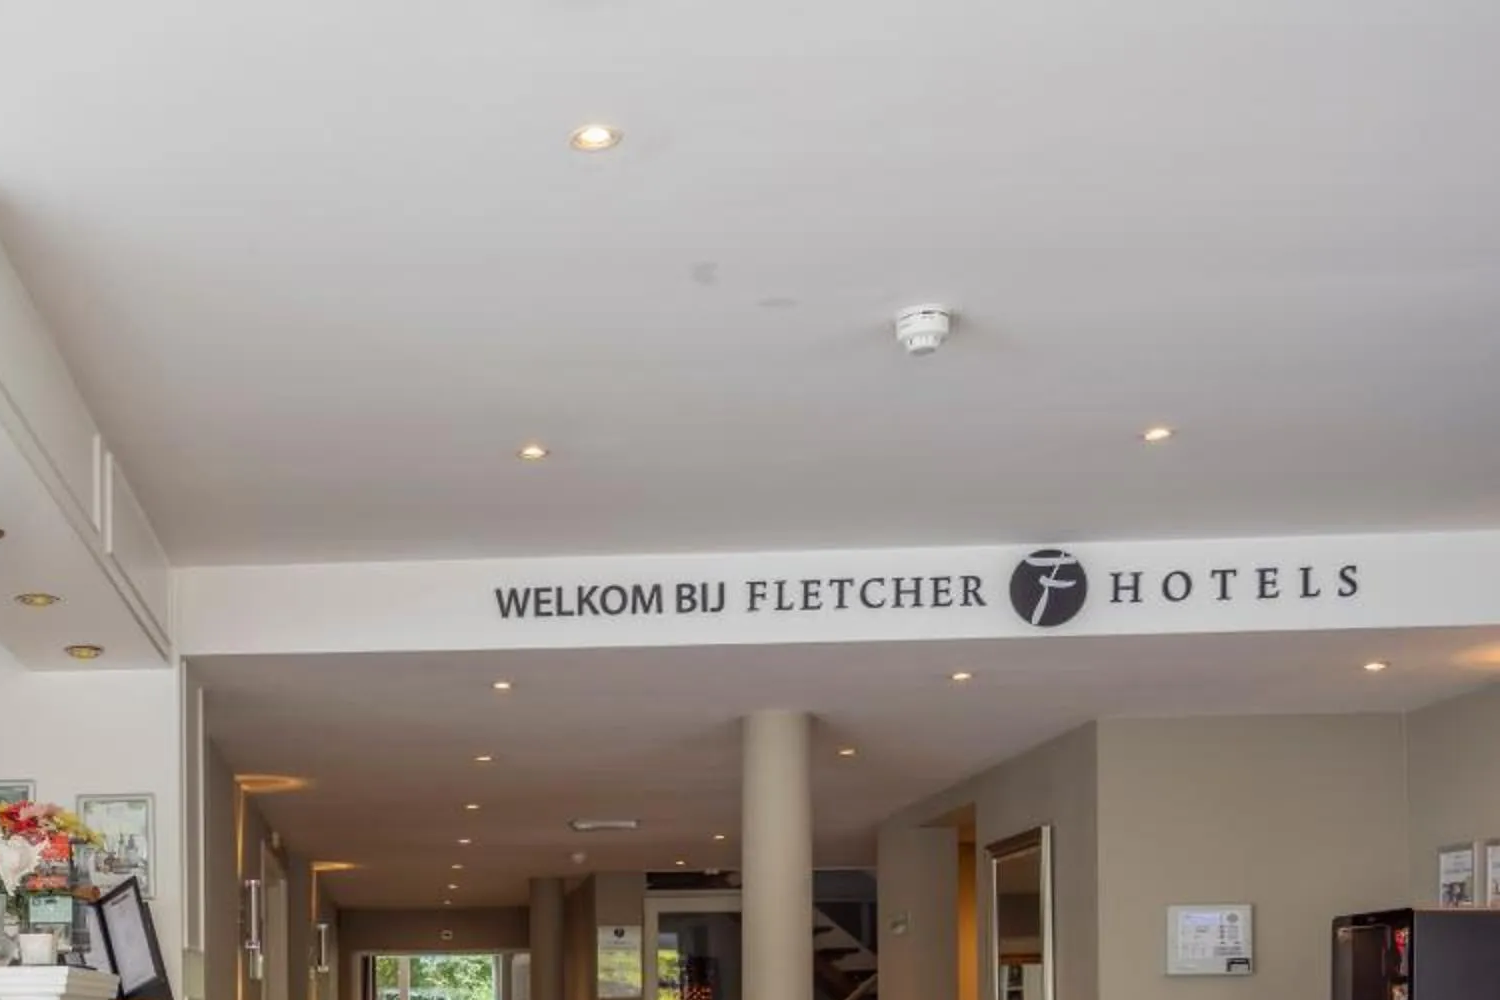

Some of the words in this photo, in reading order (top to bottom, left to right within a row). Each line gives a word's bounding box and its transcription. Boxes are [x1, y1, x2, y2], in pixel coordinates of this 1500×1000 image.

[494, 583, 664, 619] WELKOM
[675, 581, 725, 614] BIJ
[745, 575, 987, 612] FLETCHER
[1109, 564, 1358, 604] HOTELS
